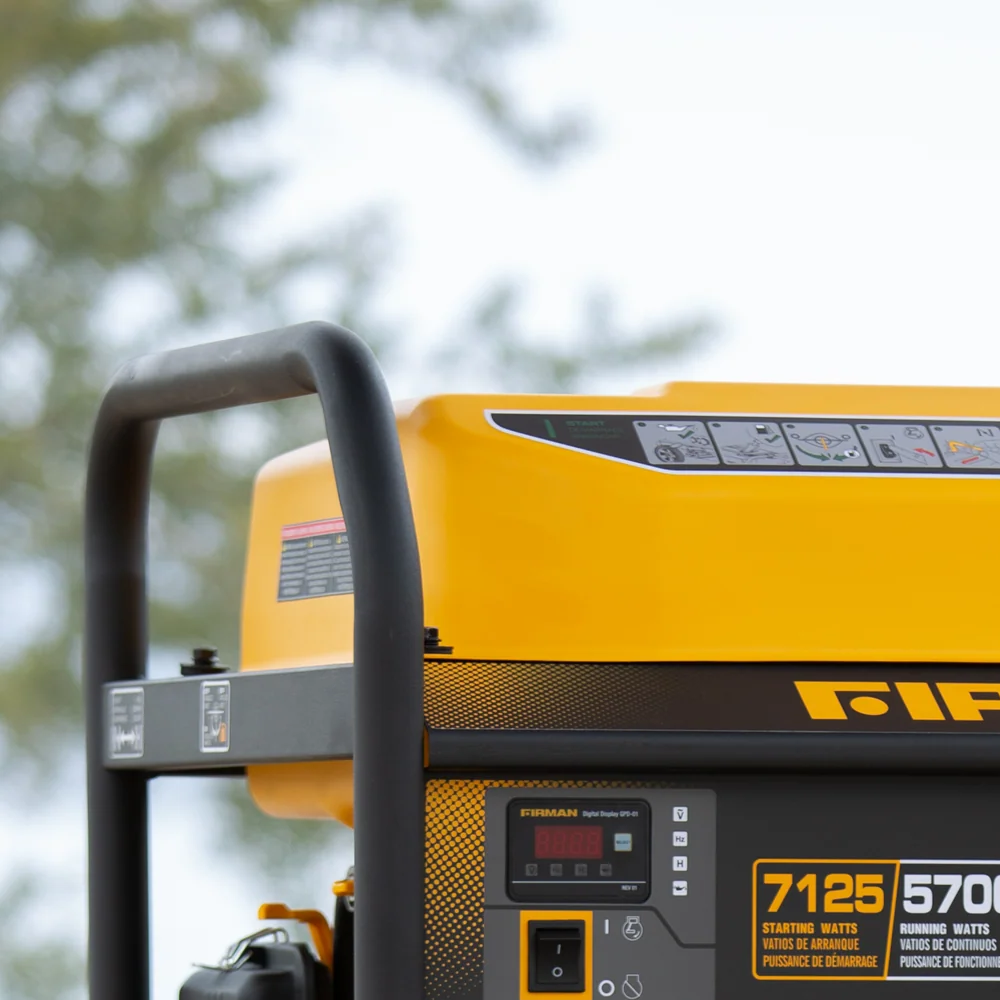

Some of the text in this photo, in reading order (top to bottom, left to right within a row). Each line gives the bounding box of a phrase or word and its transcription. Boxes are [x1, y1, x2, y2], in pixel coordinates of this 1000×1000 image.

[520, 808, 578, 818] FIRMAN
[582, 810, 599, 818] Digital
[675, 835, 685, 843] Hz
[677, 860, 684, 868] H
[763, 873, 885, 913] 7125
[762, 922, 858, 934] STARTING WATTS
[900, 923, 990, 935] RUNNING WATTS
[763, 937, 860, 951] VATIOS DE ARRANQUE
[900, 938, 997, 951] VATIOS DE CONTINUOS
[763, 952, 878, 968] PUISSANCE DE DÉMARRAGE
[900, 956, 942, 969] PUISSANCE
[943, 956, 954, 969] DE
